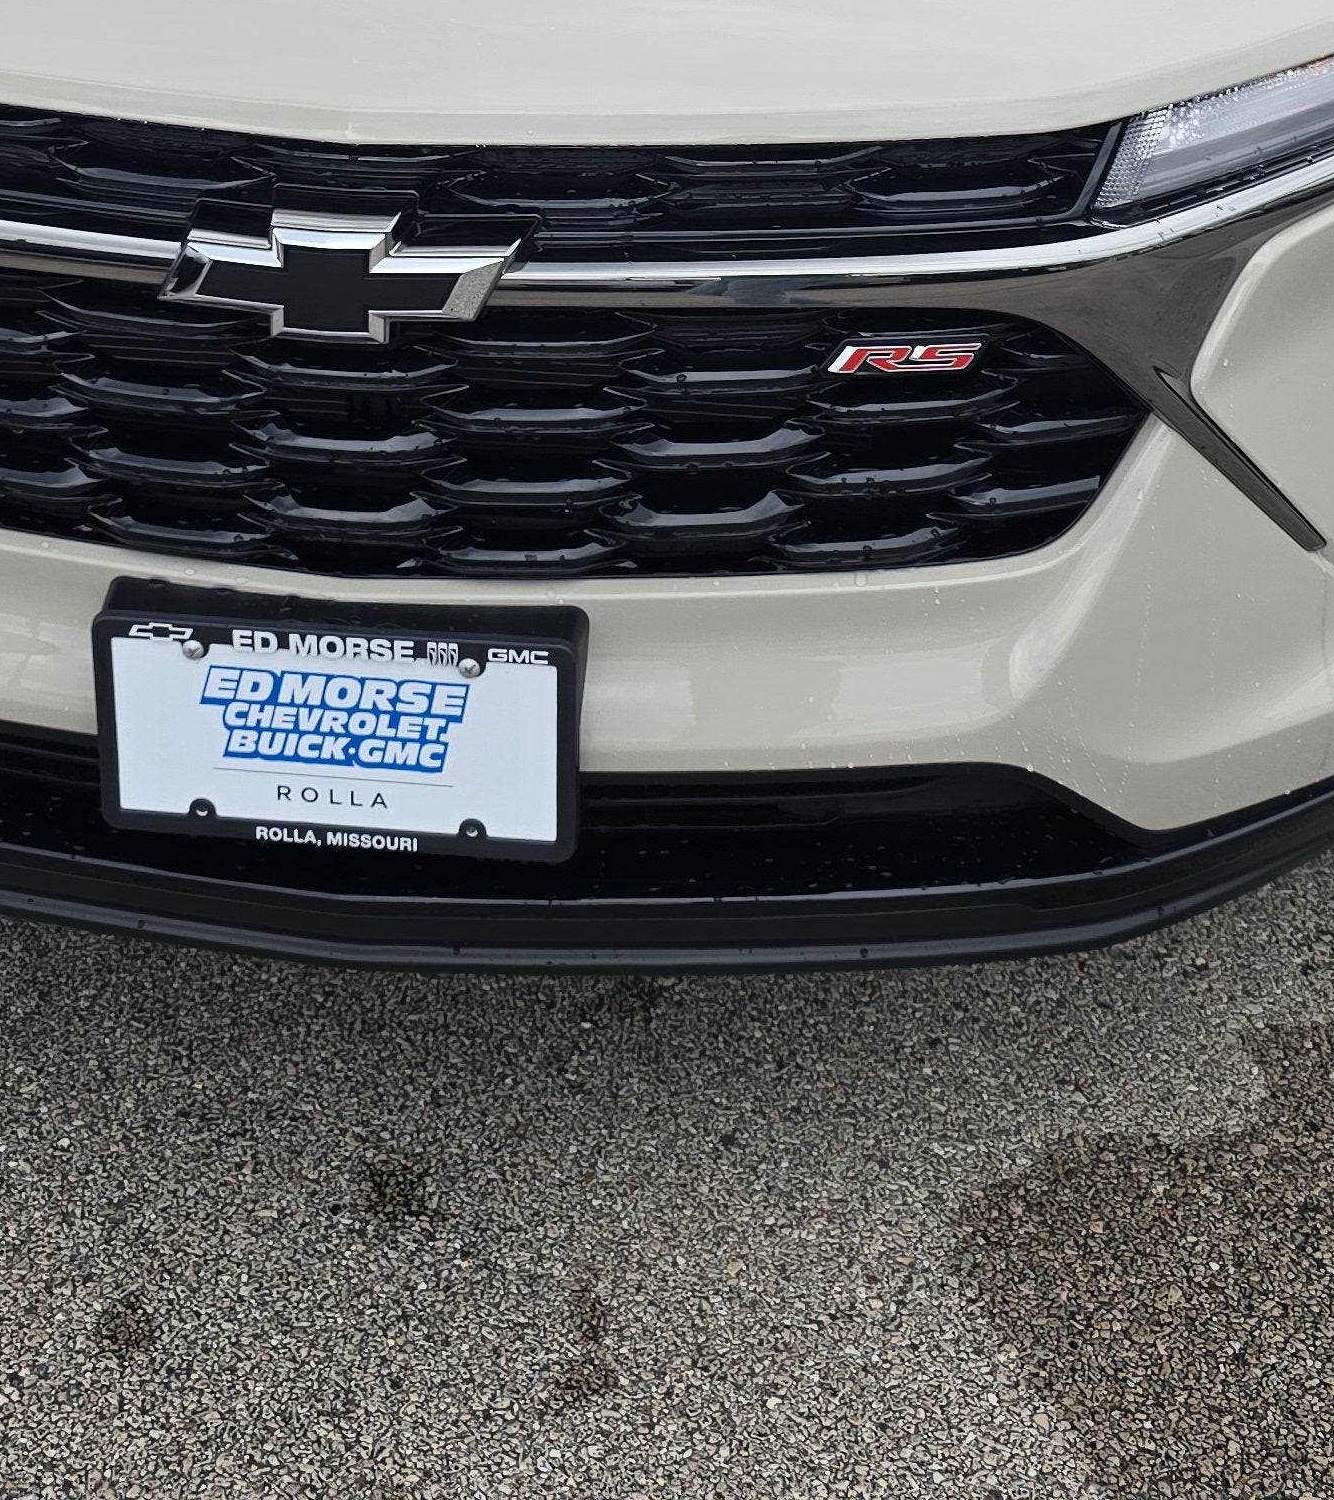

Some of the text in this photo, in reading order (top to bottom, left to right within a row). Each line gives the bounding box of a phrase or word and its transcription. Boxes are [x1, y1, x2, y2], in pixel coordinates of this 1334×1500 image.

[827, 342, 982, 374] RS
[232, 629, 549, 665] ED MORSE GMC
[203, 667, 469, 717] ED MORSE
[276, 784, 388, 809] ROLLA
[255, 825, 418, 852] ROLLA, MISSOURI
